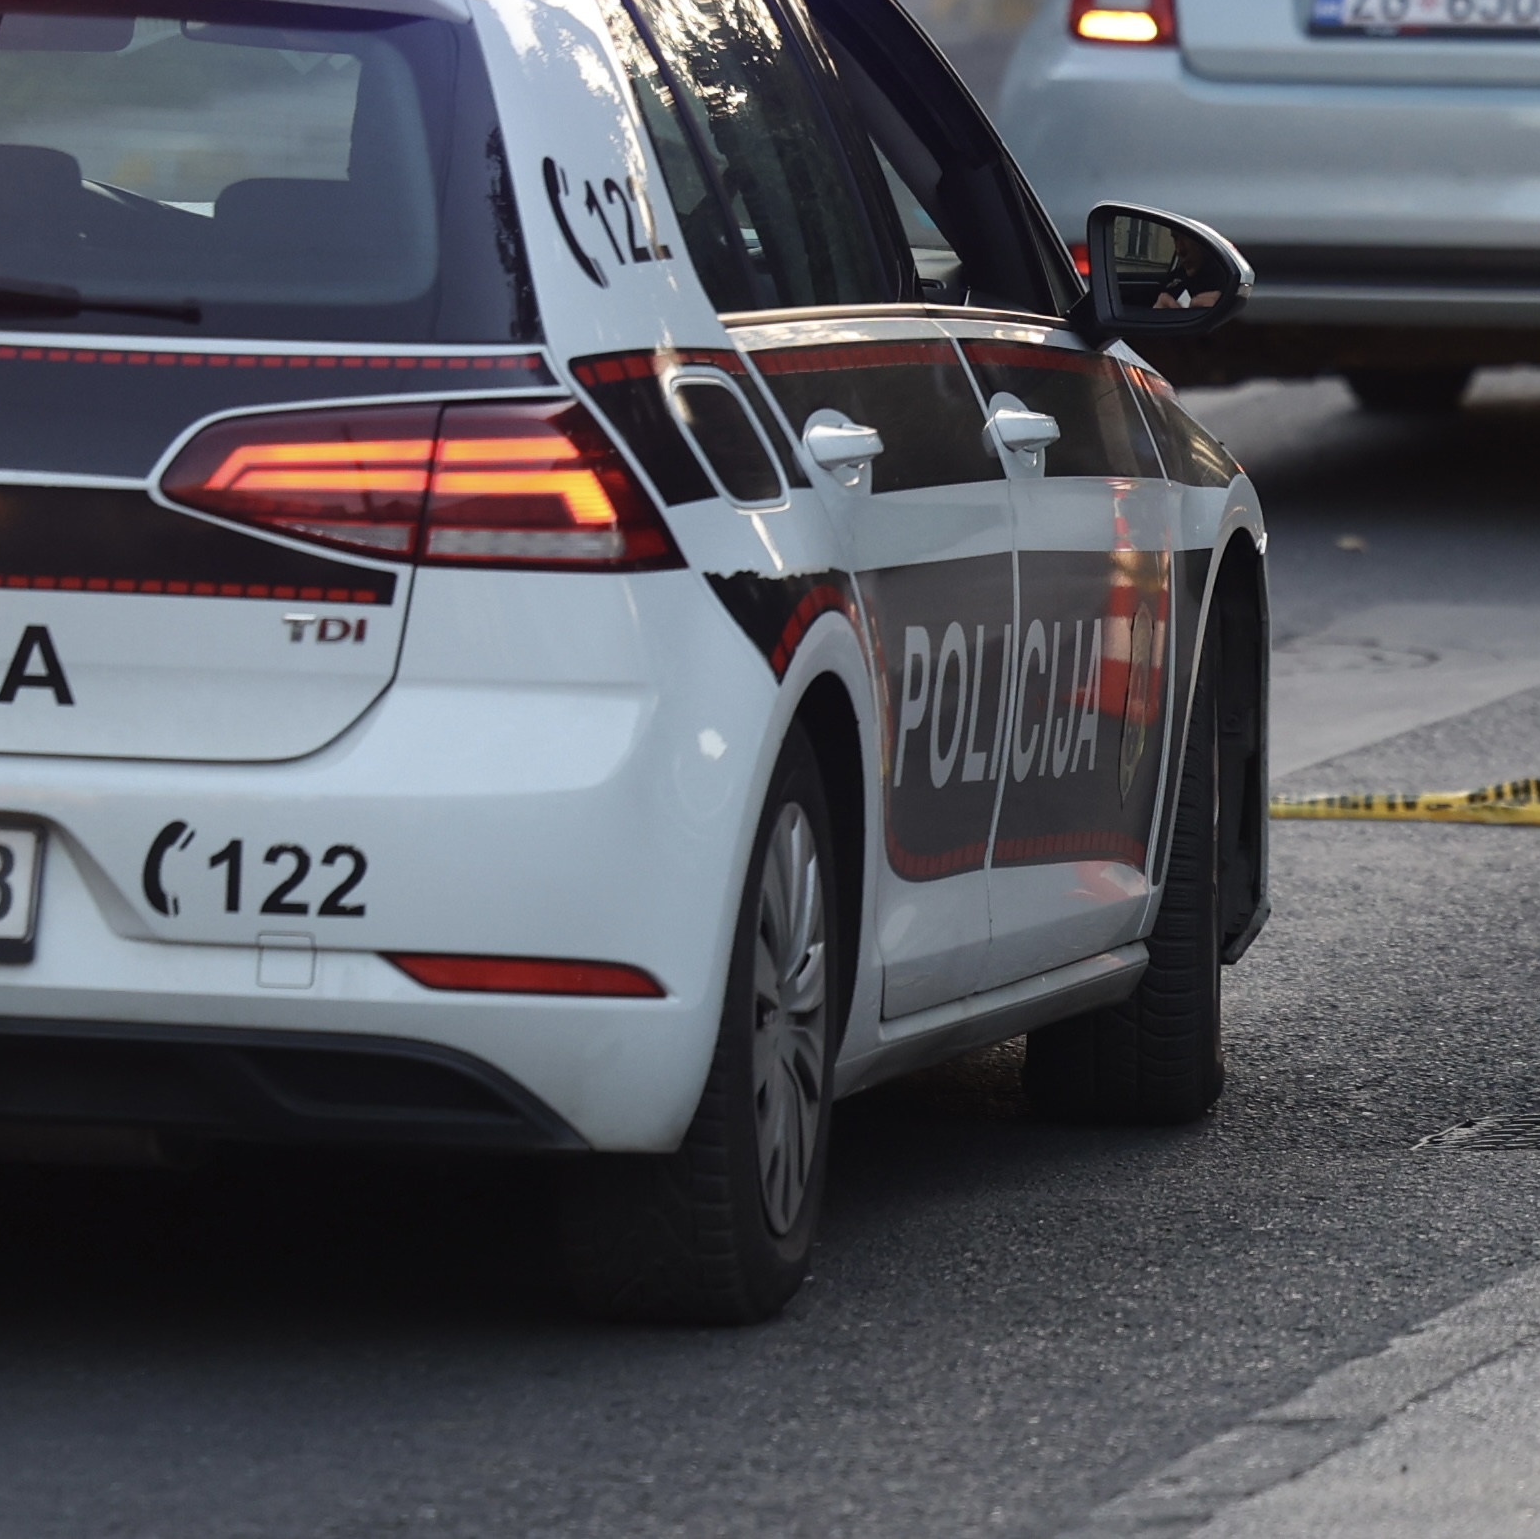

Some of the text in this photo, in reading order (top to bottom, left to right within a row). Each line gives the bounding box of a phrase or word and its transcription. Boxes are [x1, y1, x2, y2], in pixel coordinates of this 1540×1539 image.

[584, 177, 674, 266] 122
[282, 612, 367, 644] TDI
[893, 617, 1103, 790] POLICIJA
[209, 839, 368, 918] 122
